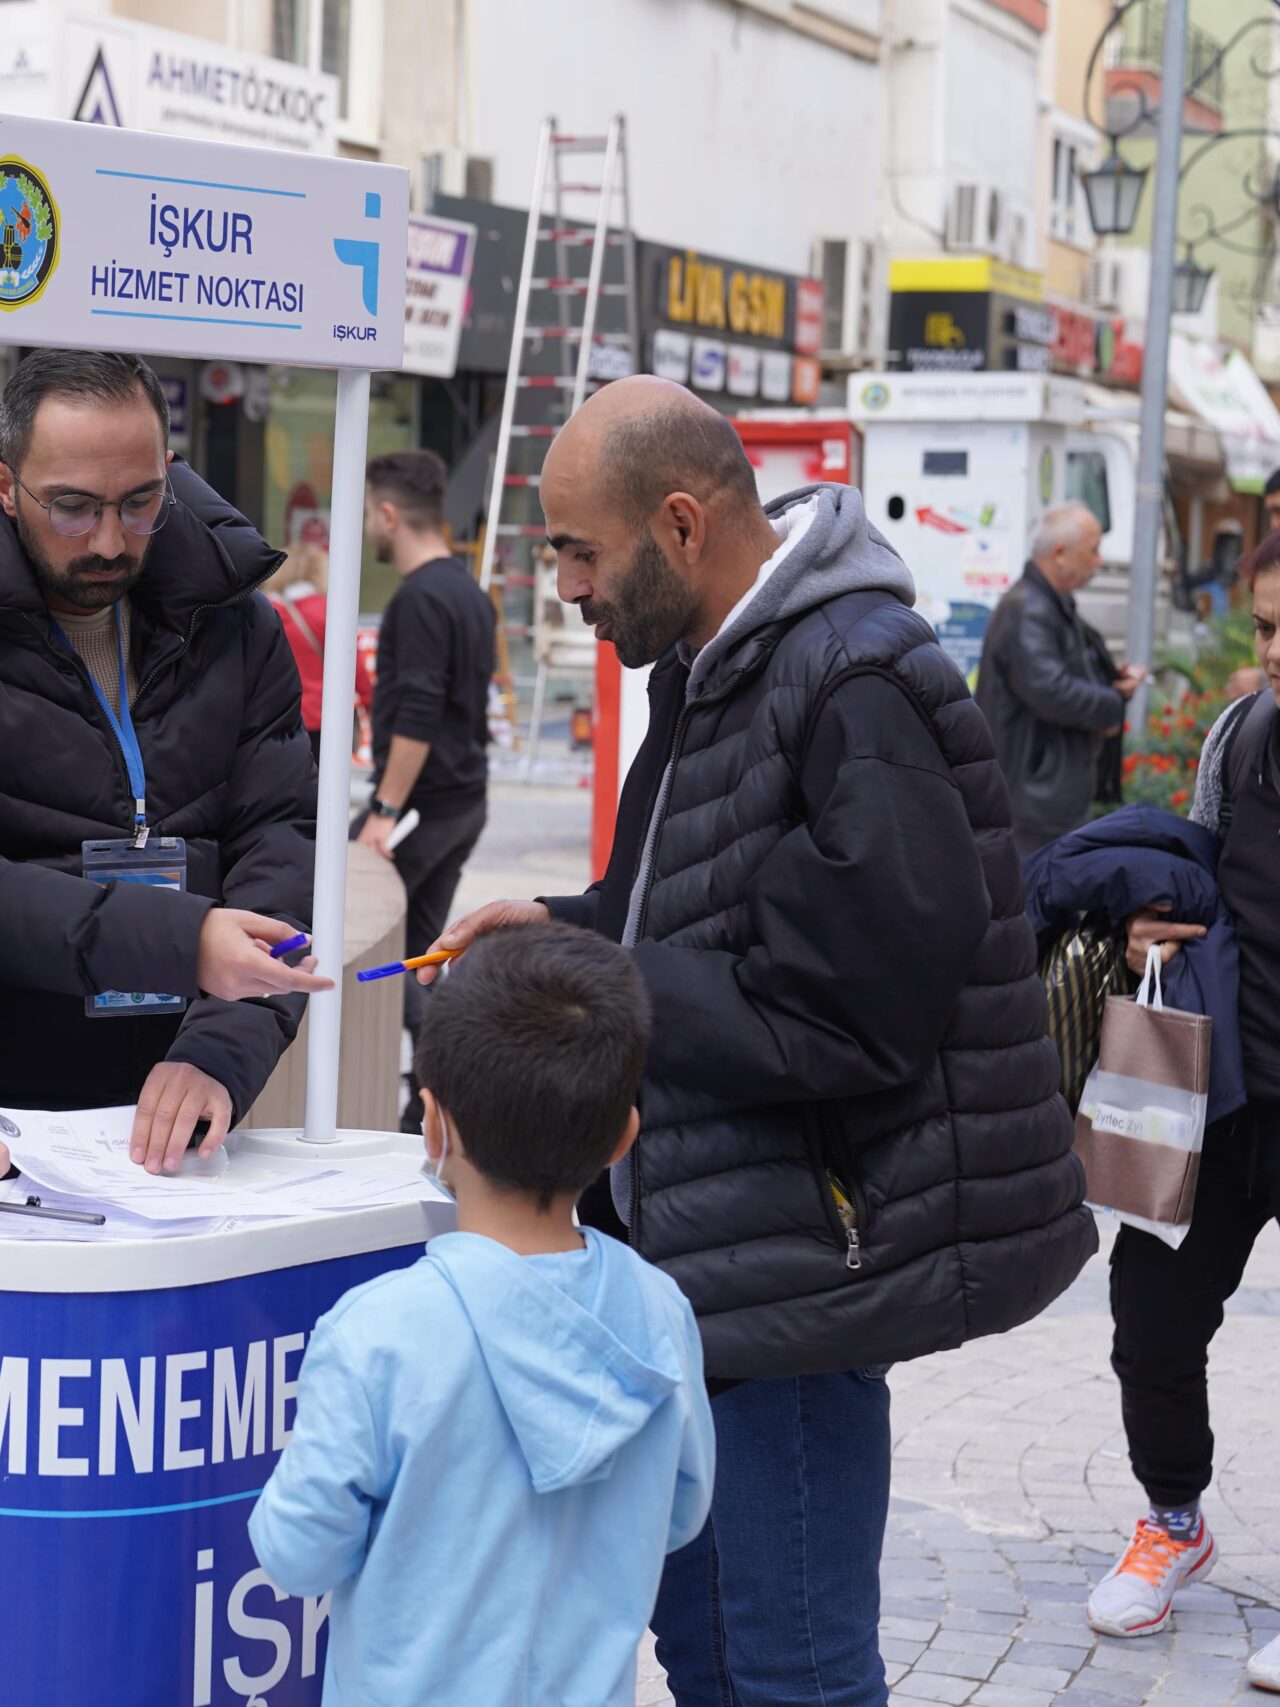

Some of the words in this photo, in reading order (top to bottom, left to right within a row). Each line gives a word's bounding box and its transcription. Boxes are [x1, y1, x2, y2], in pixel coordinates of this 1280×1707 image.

[149, 192, 254, 257] İŞKUR
[91, 260, 190, 304] HİZMET
[197, 274, 305, 313] NOKTASI
[729, 270, 786, 339] GSM
[333, 324, 378, 342] İŞKUR
